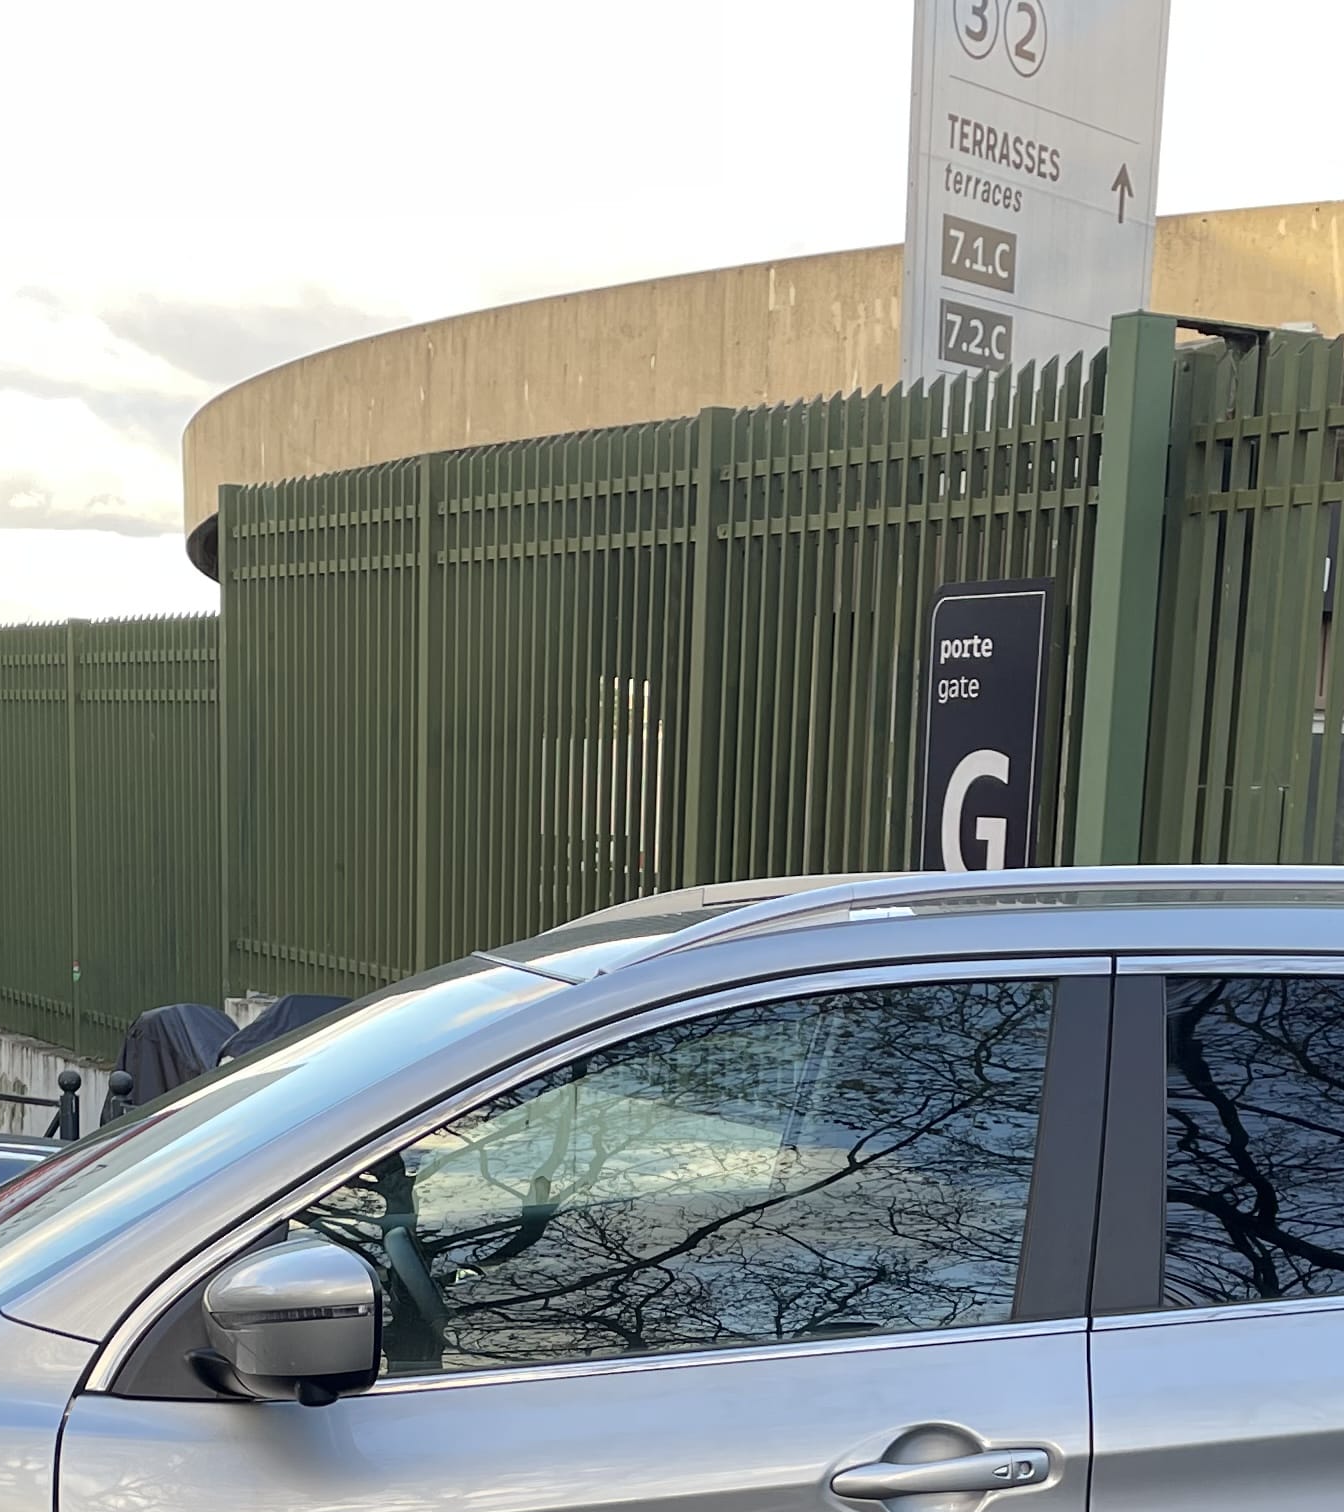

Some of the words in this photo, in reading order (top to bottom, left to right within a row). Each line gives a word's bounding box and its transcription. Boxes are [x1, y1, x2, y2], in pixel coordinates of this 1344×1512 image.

[1014, 2, 1038, 63] 2
[947, 113, 1061, 182] TERRASSES
[944, 163, 1022, 213] terraces
[949, 229, 1011, 278] 7.1.C
[946, 313, 1006, 361] 7.2.C
[940, 635, 993, 664] porte
[938, 676, 979, 703] gate
[941, 749, 1009, 872] G
